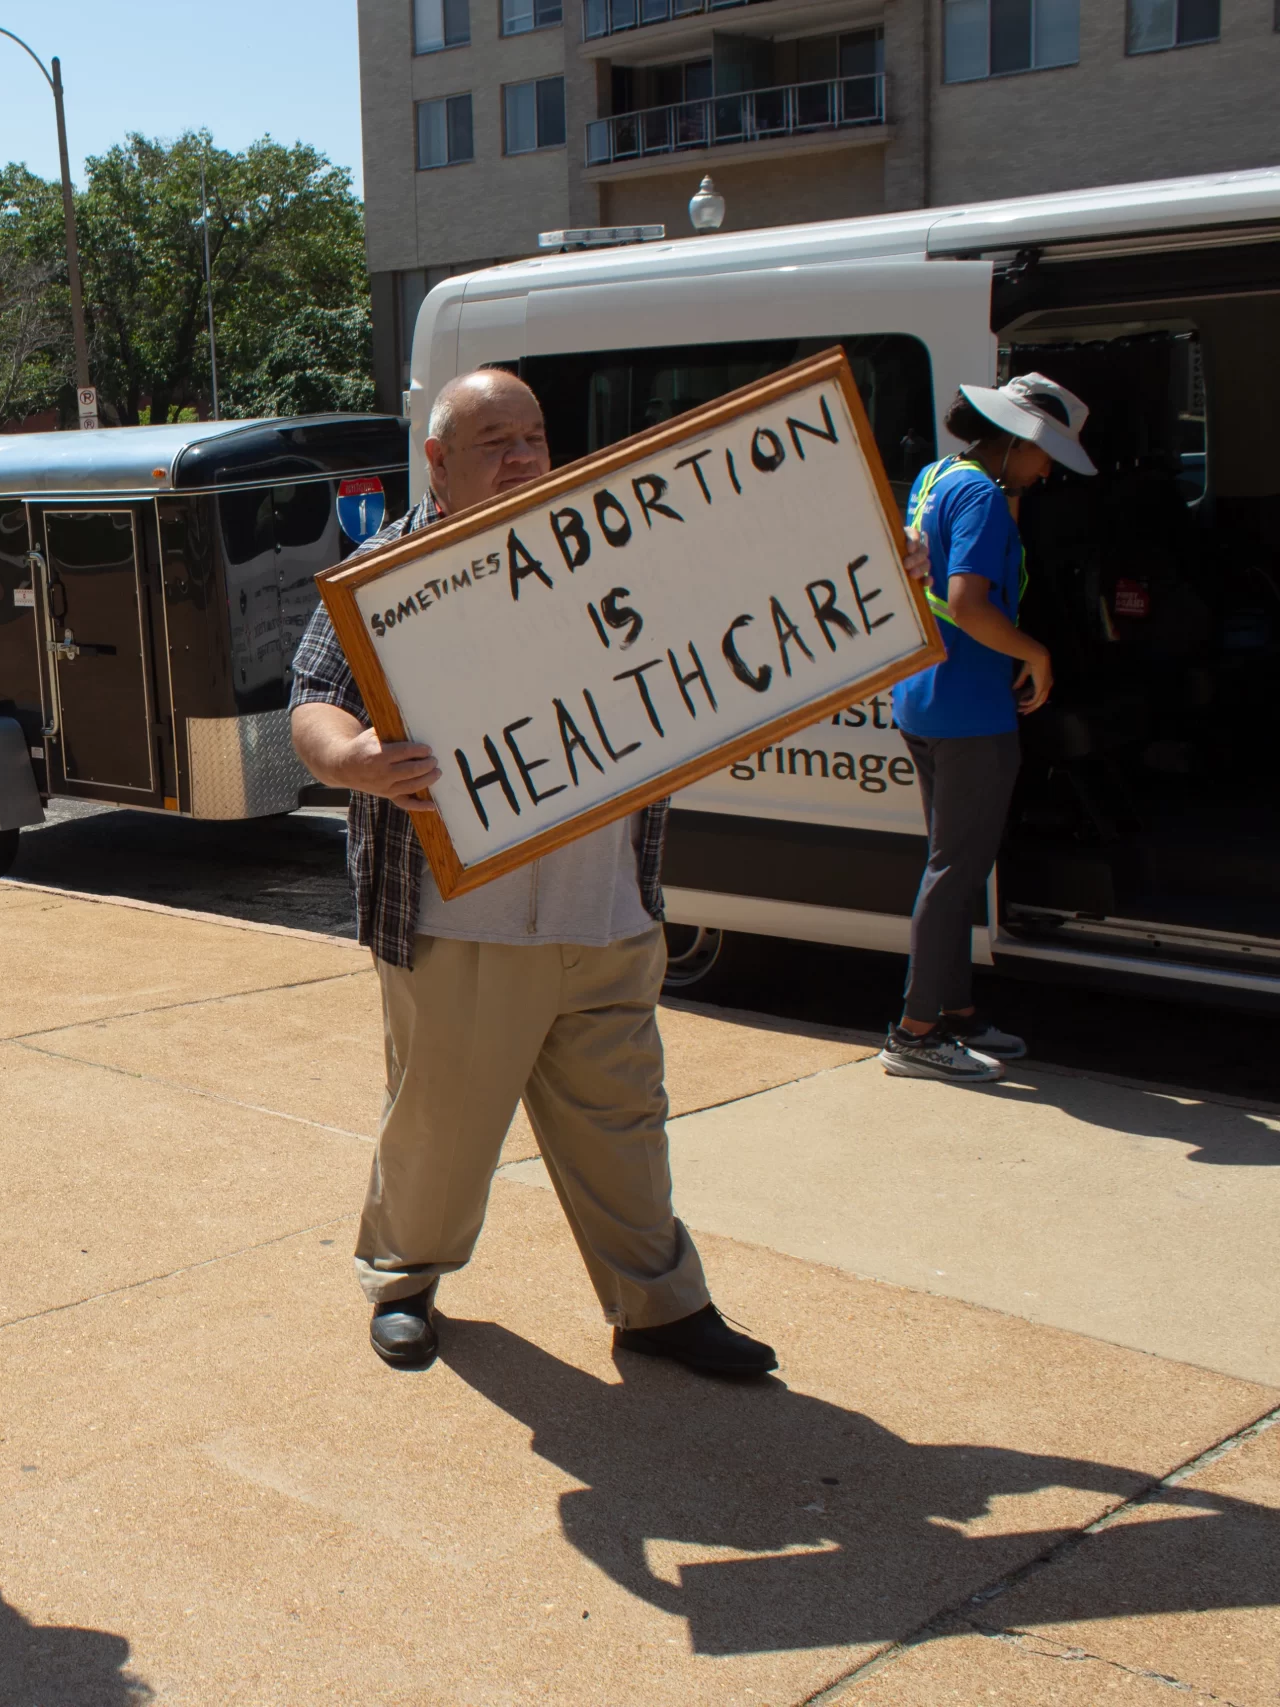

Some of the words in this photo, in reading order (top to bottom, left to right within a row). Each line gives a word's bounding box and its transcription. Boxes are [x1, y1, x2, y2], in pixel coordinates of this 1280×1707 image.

[371, 552, 501, 637] SOMETIMES
[507, 395, 839, 600] ABORTION
[587, 587, 643, 650] IS
[454, 555, 894, 831] HEALTHCARE
